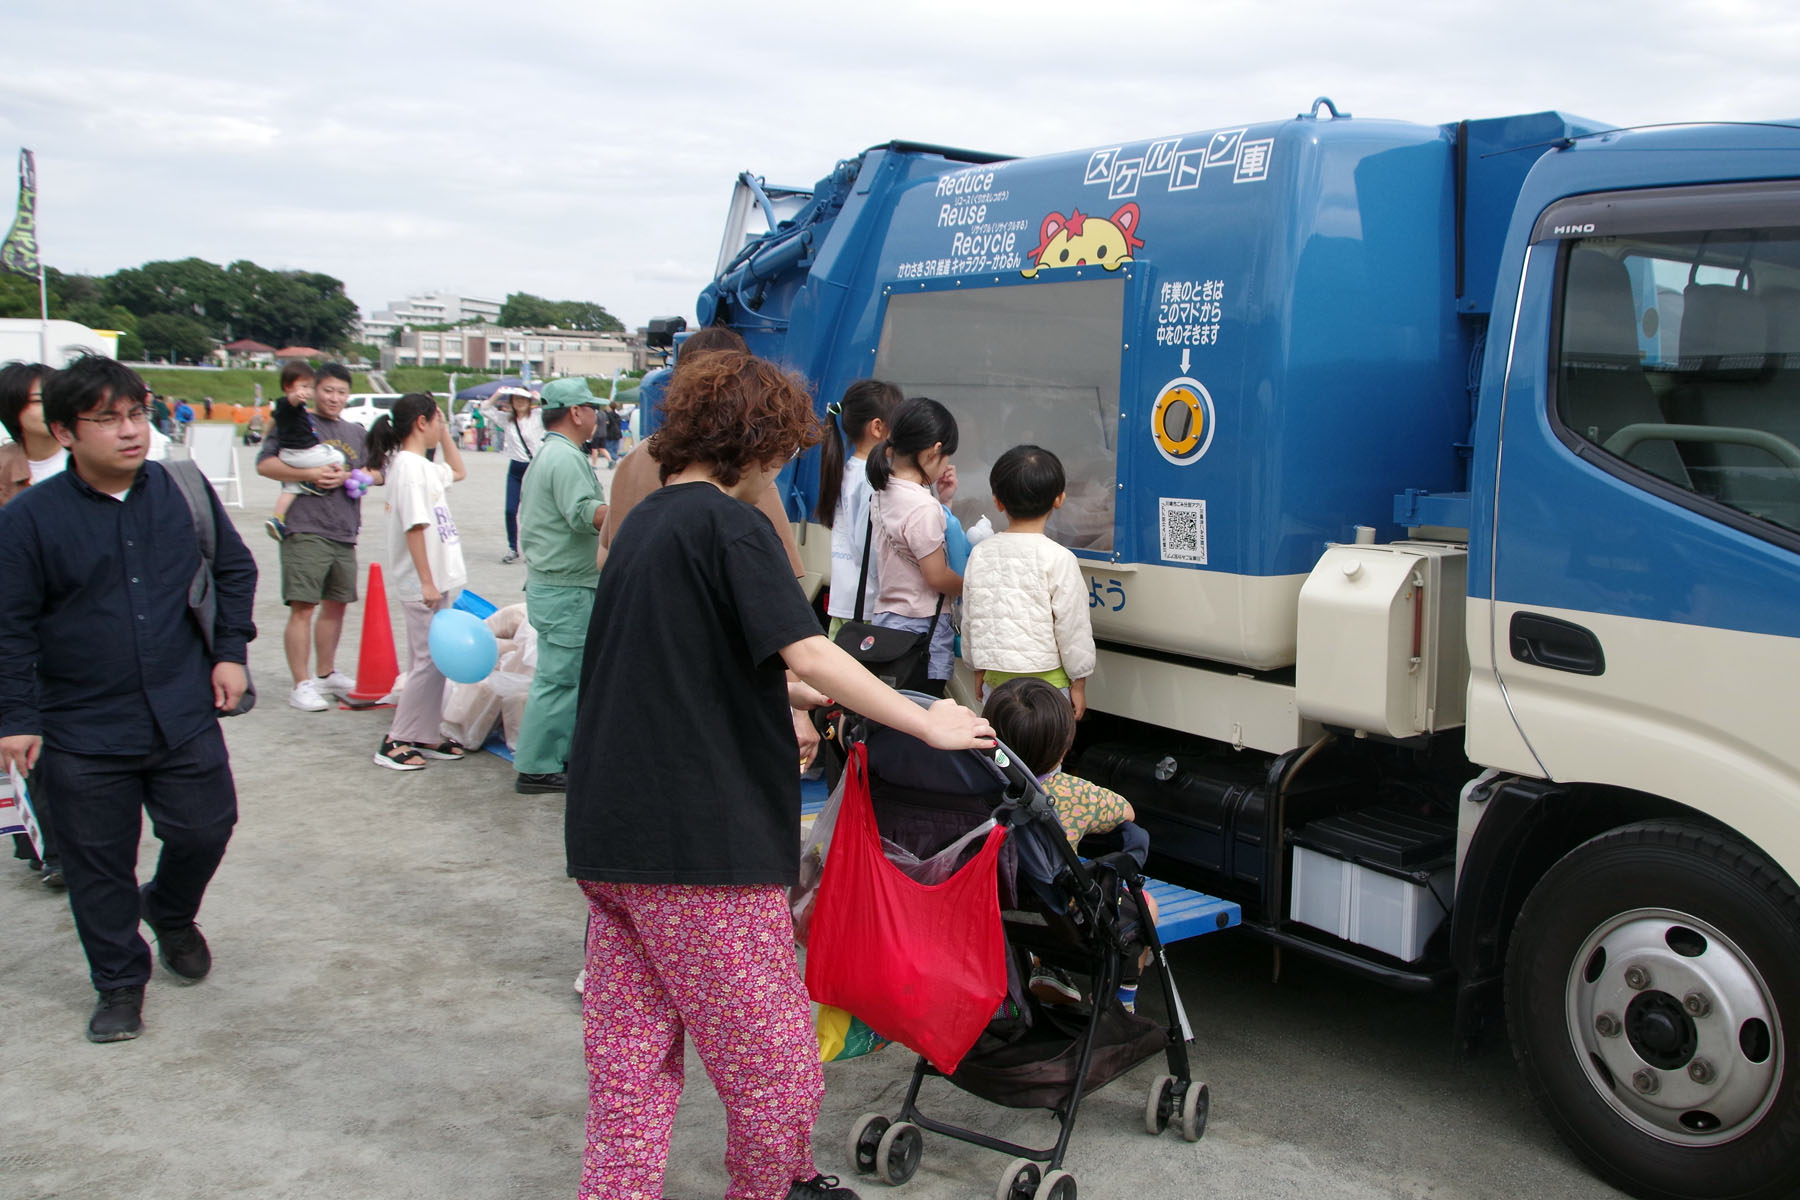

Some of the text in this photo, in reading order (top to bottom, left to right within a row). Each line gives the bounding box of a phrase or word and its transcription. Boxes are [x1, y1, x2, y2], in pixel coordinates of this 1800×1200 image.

[1087, 133, 1268, 195] スケルトン車
[935, 172, 995, 197] Reduce
[937, 203, 987, 228] Reuse
[1554, 223, 1596, 234] HINO
[951, 231, 1016, 256] Recycle
[1160, 279, 1225, 303] 作業のときは
[1158, 301, 1222, 324] このマドから
